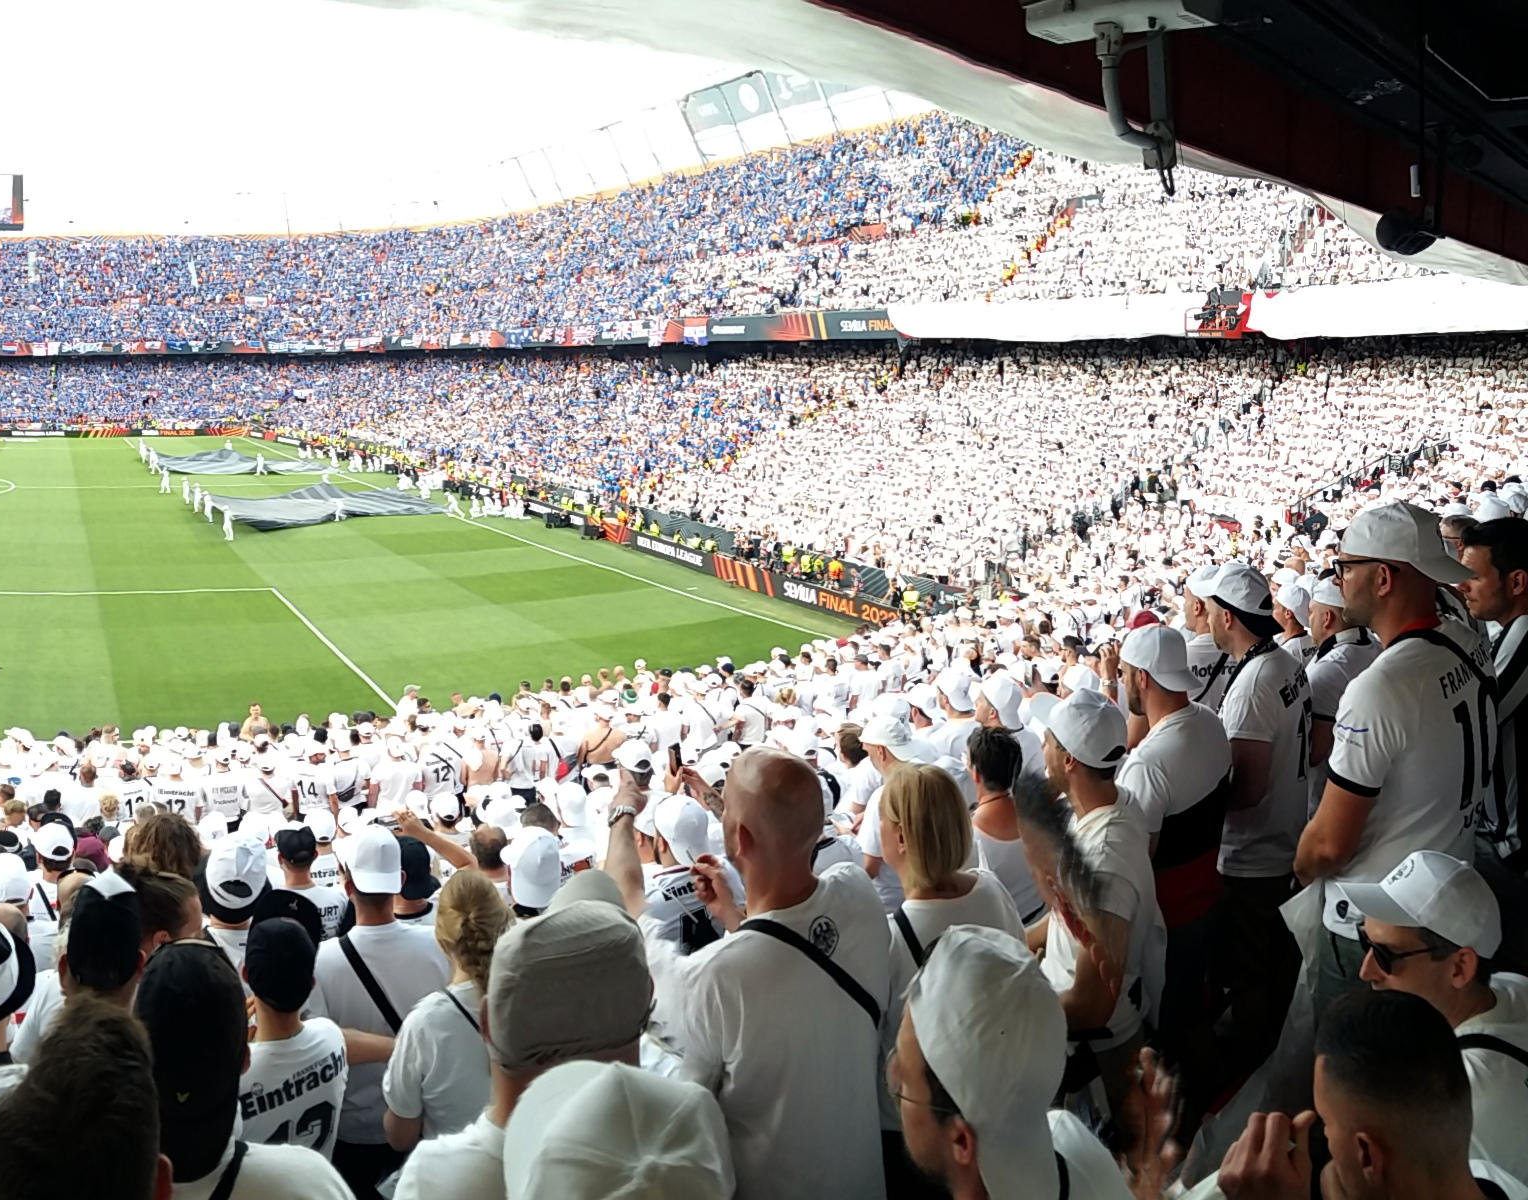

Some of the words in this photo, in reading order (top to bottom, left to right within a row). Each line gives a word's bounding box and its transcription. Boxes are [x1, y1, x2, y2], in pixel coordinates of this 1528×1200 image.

[840, 320, 867, 332] SEVILLA
[783, 581, 817, 605] SEVILLA
[818, 590, 857, 620] FINAL
[433, 765, 451, 783] 12
[297, 779, 319, 799] 14
